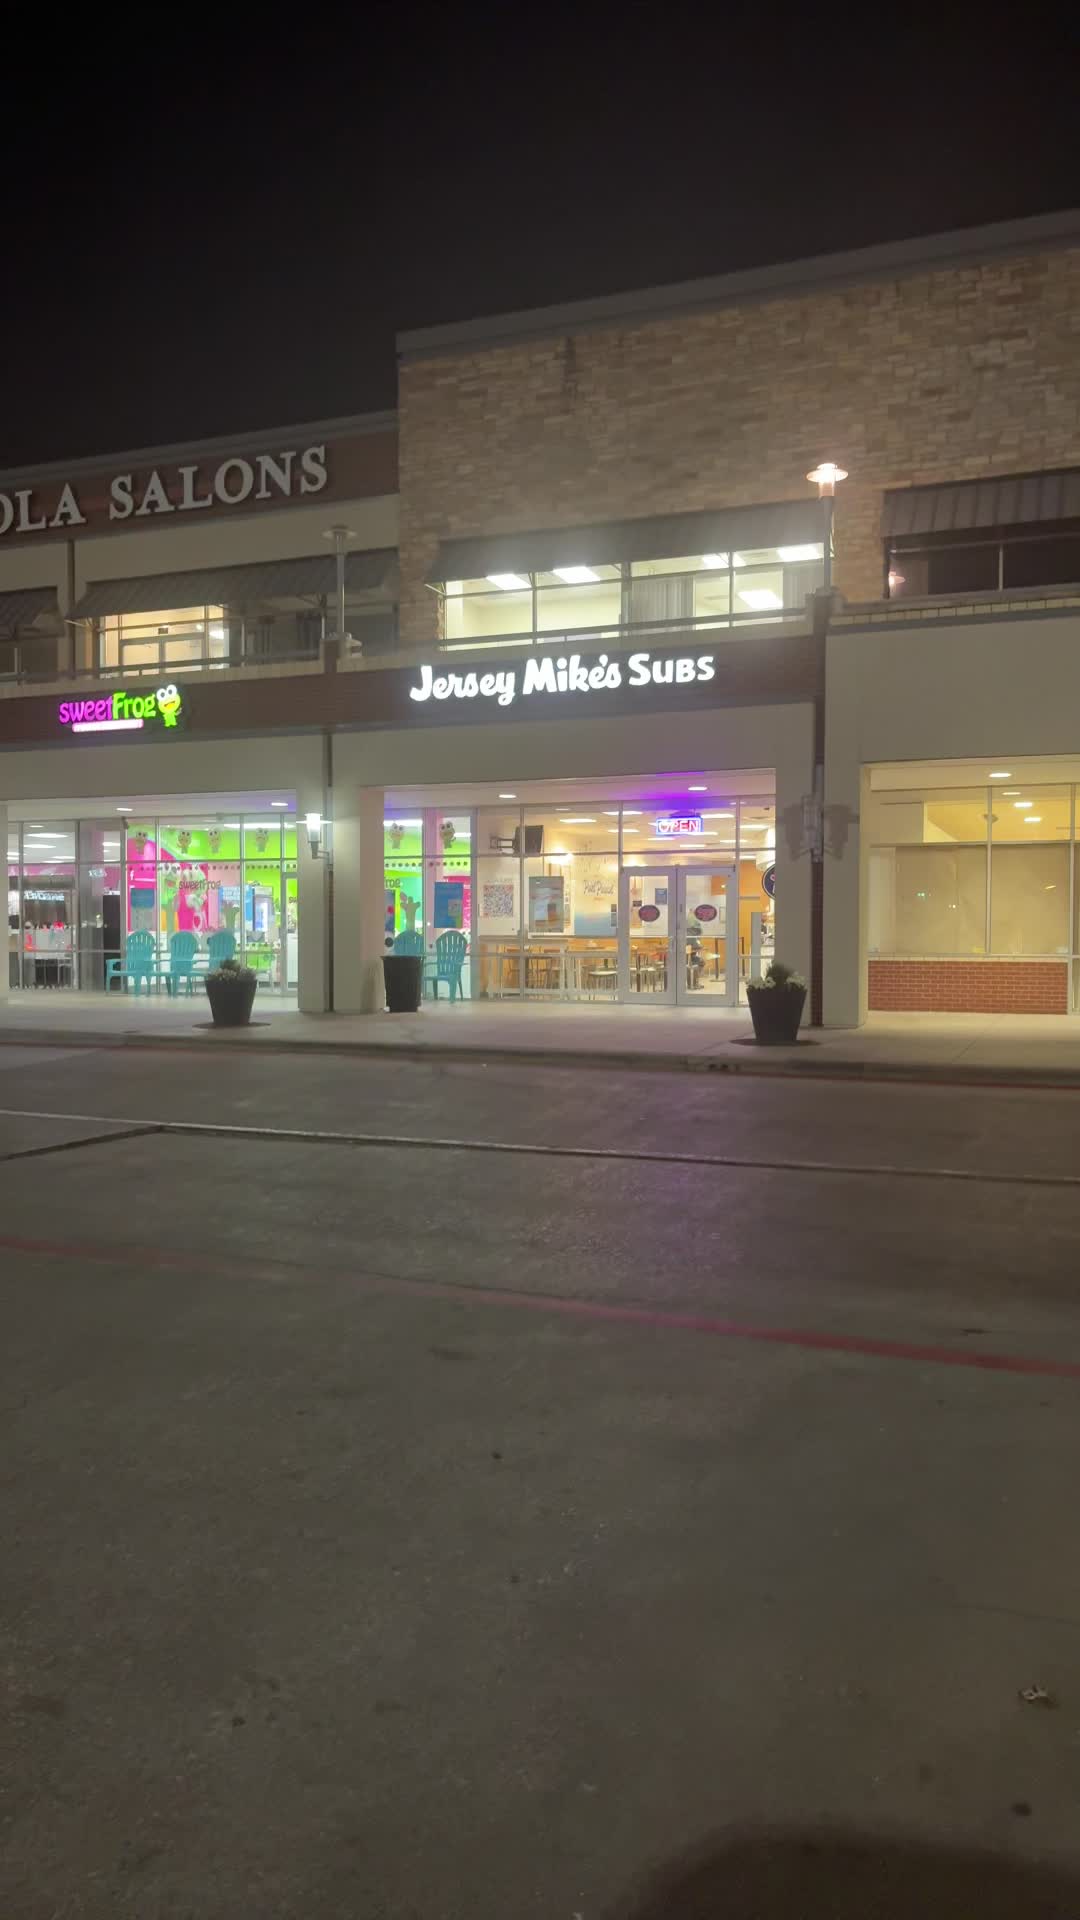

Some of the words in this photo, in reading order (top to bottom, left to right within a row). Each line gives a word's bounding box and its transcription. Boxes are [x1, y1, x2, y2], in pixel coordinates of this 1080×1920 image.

[109, 445, 328, 520] SALONS
[409, 665, 516, 706] Jersey
[522, 654, 621, 695] Mike's
[59, 692, 156, 723] sweetFrog
[658, 819, 699, 833] OPEN
